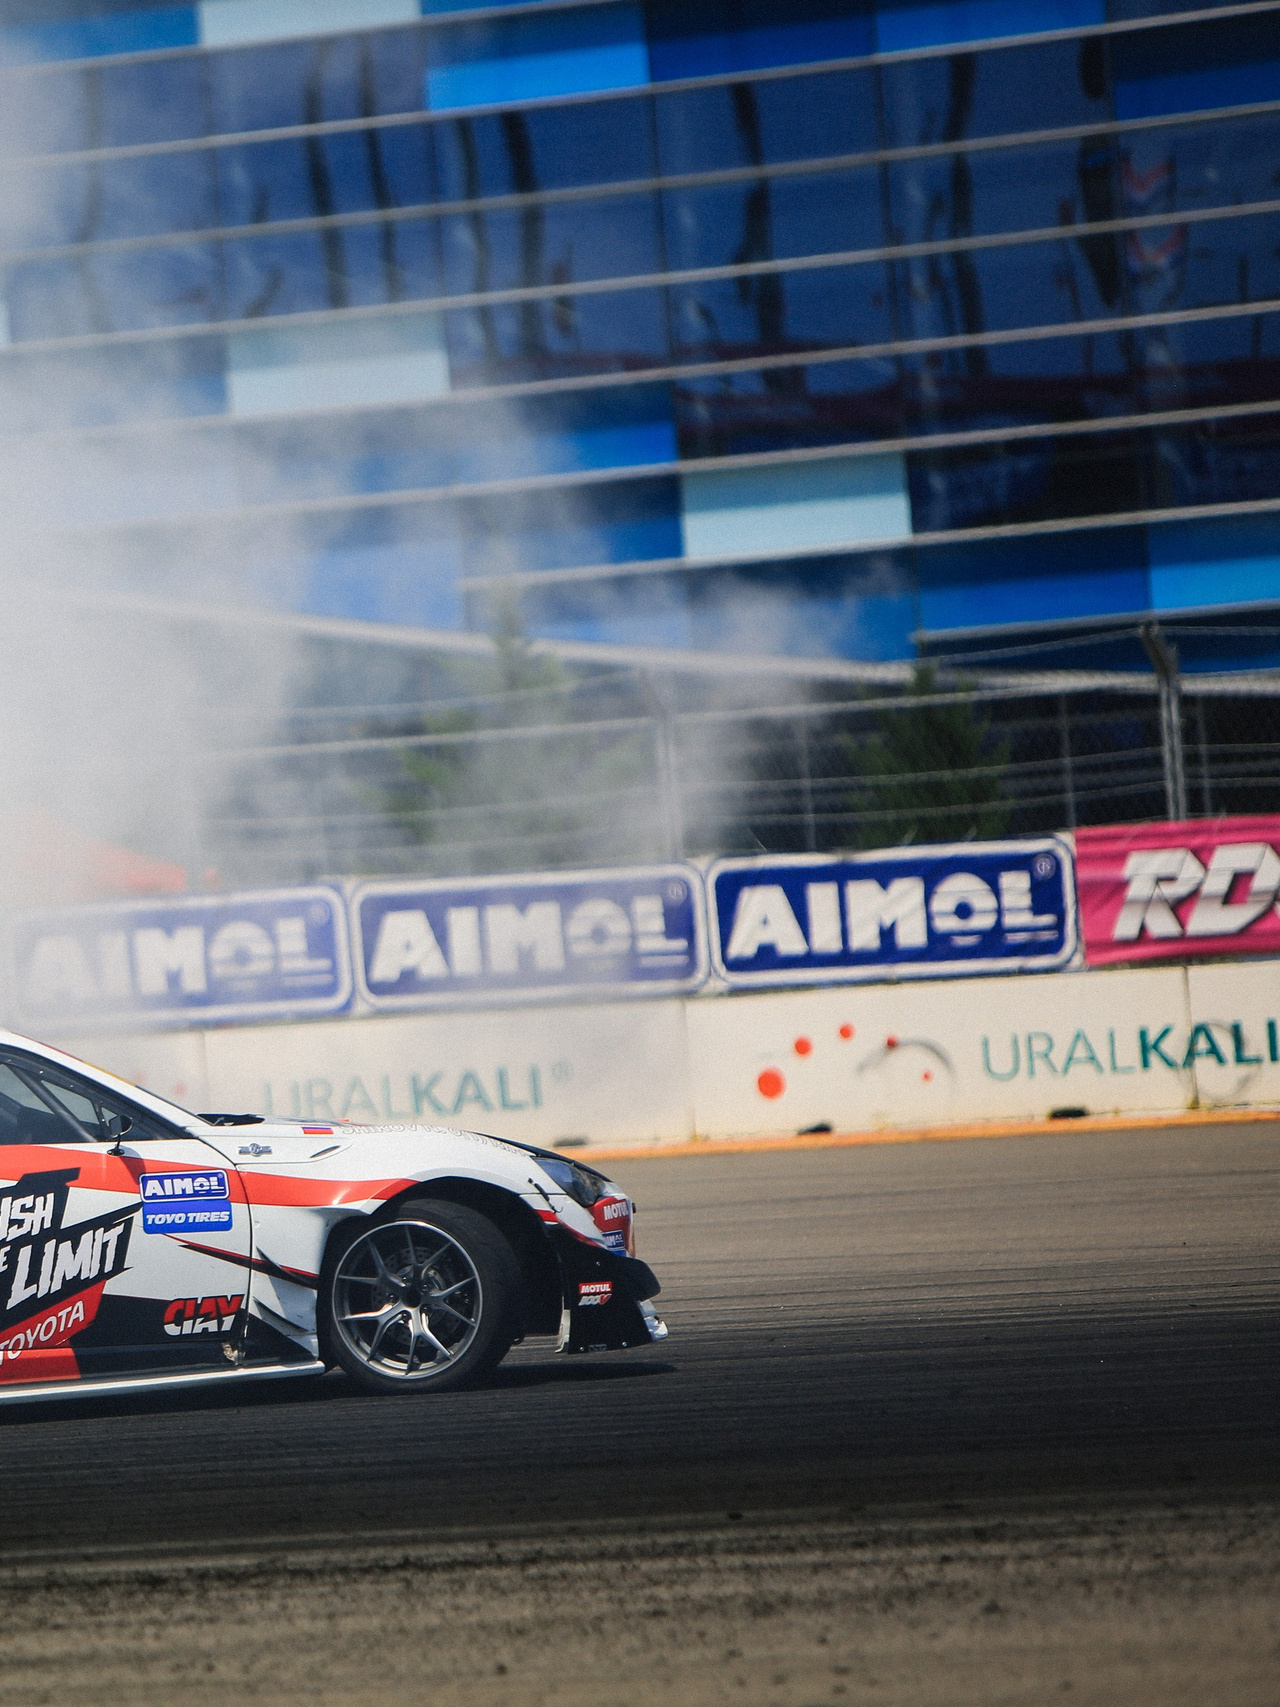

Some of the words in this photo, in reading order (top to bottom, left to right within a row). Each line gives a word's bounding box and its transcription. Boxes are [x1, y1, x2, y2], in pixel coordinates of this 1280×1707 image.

[727, 870, 1058, 960] AIMOL
[1113, 841, 1280, 941] RD
[24, 917, 331, 998] AIMOL
[371, 894, 688, 982] AIMOL
[981, 1018, 1280, 1081] URALKALI
[263, 1063, 543, 1119] URALKALI
[144, 1176, 225, 1197] AIMOL
[146, 1213, 186, 1225] TOYO
[187, 1211, 231, 1223] TIRES
[603, 1200, 629, 1221] MOTUL
[6, 1222, 125, 1310] LIMIT
[580, 1284, 611, 1294] MOTUL
